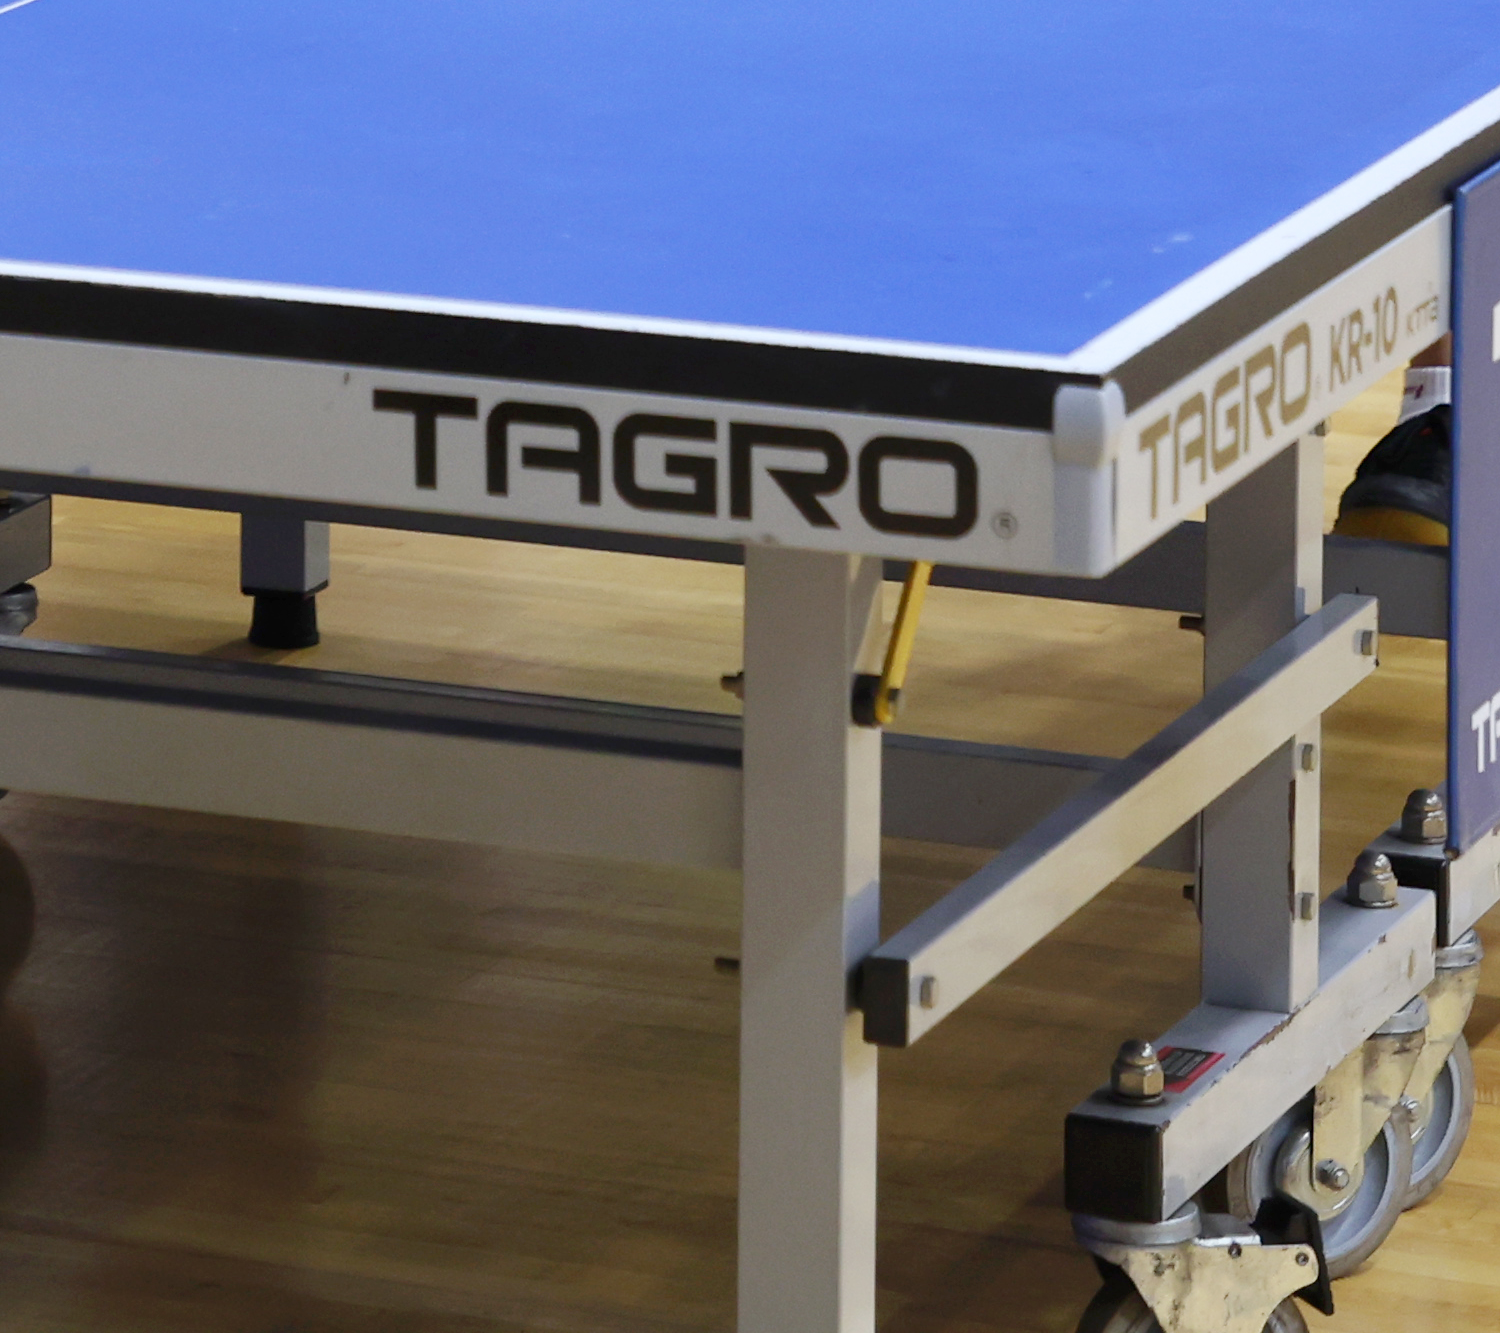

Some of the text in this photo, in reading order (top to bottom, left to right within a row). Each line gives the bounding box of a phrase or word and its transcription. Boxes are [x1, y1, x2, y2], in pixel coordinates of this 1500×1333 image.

[372, 388, 979, 541] TAGRO
[1139, 321, 1312, 521] TAGRO
[1329, 285, 1399, 393] KR-10
